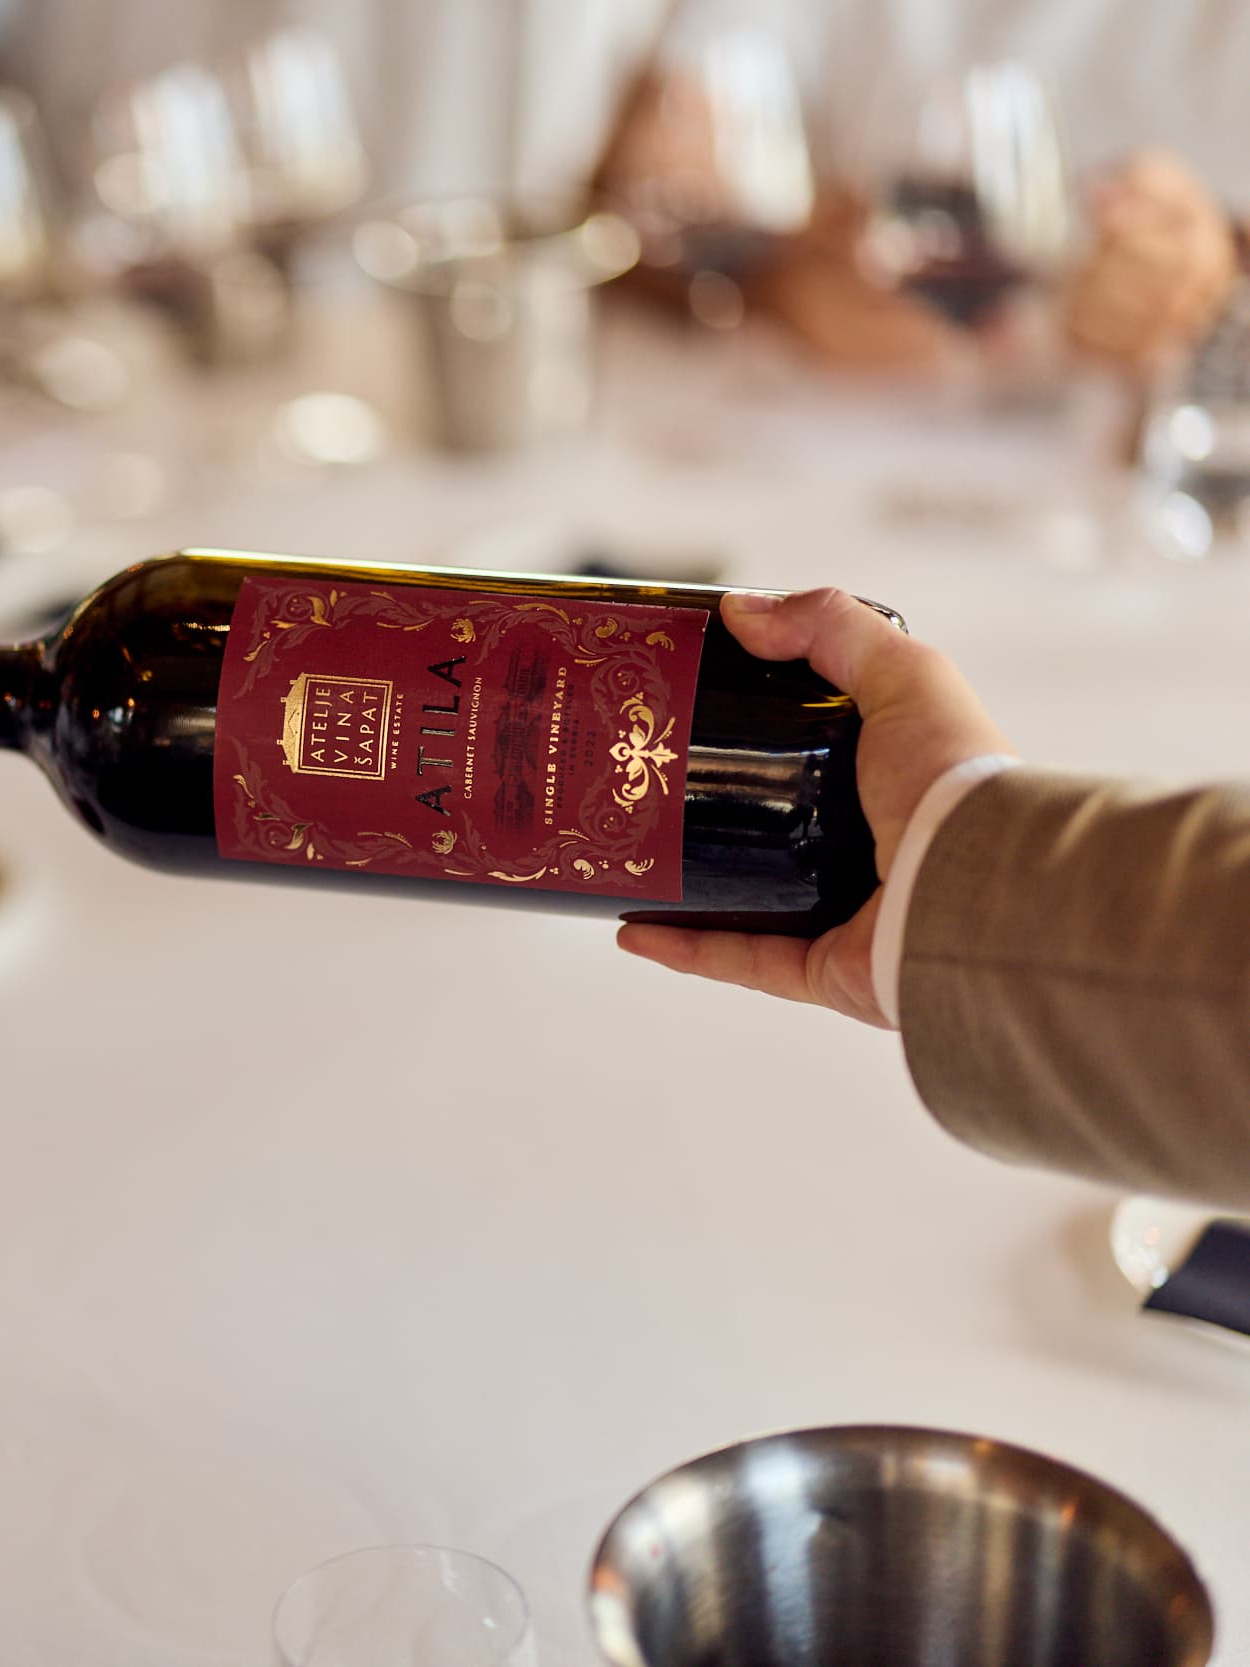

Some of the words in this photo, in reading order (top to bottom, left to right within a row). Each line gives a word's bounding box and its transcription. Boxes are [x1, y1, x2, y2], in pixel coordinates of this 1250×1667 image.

[311, 687, 332, 762] ATELJE
[333, 690, 355, 763] VINA
[353, 691, 378, 766] ŠAPAT
[393, 693, 404, 735] ESTATE
[415, 655, 466, 817] ATILA
[467, 677, 482, 740] SAUVIGNON
[548, 667, 567, 755] VINEYARD
[391, 741, 399, 769] WINE
[464, 745, 475, 800] CABERNET
[544, 763, 557, 825] SINGLE
